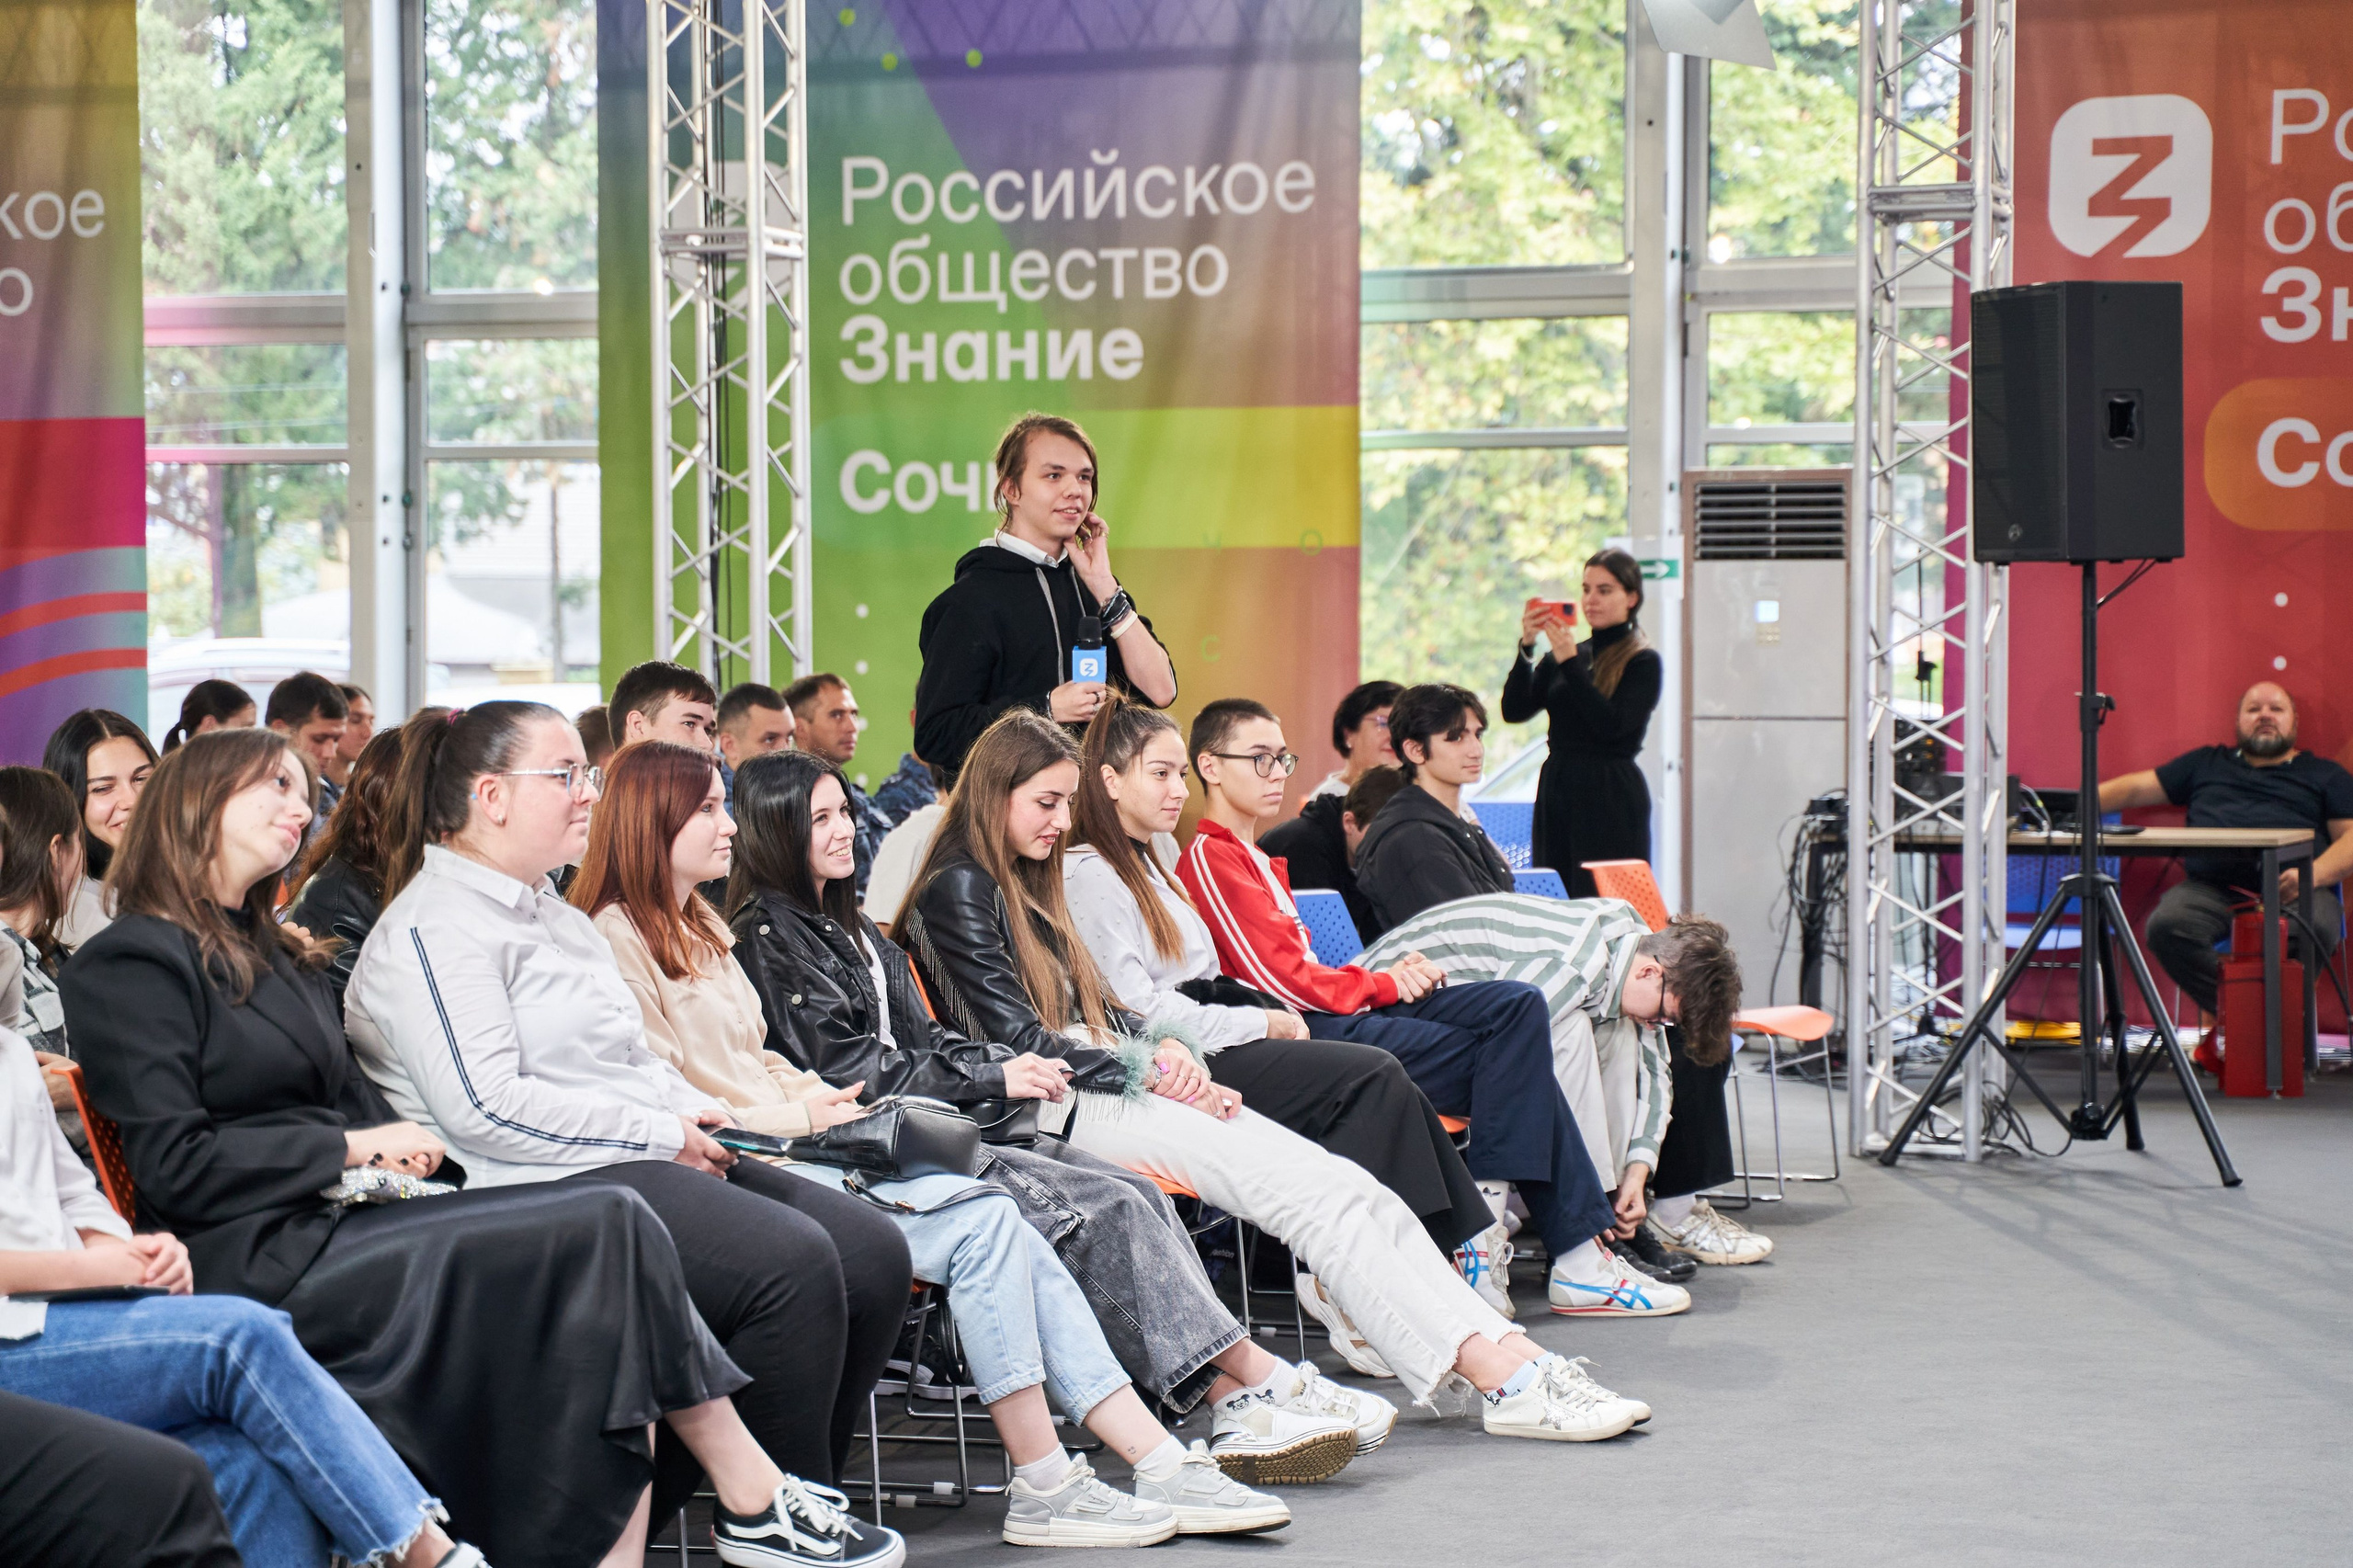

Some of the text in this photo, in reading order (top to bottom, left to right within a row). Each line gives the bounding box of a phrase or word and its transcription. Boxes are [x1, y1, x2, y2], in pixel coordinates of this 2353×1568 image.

[840, 149, 1316, 226] Российское
[838, 234, 1229, 312] общество
[839, 314, 1144, 384] Знание
[839, 449, 998, 514] Соч
